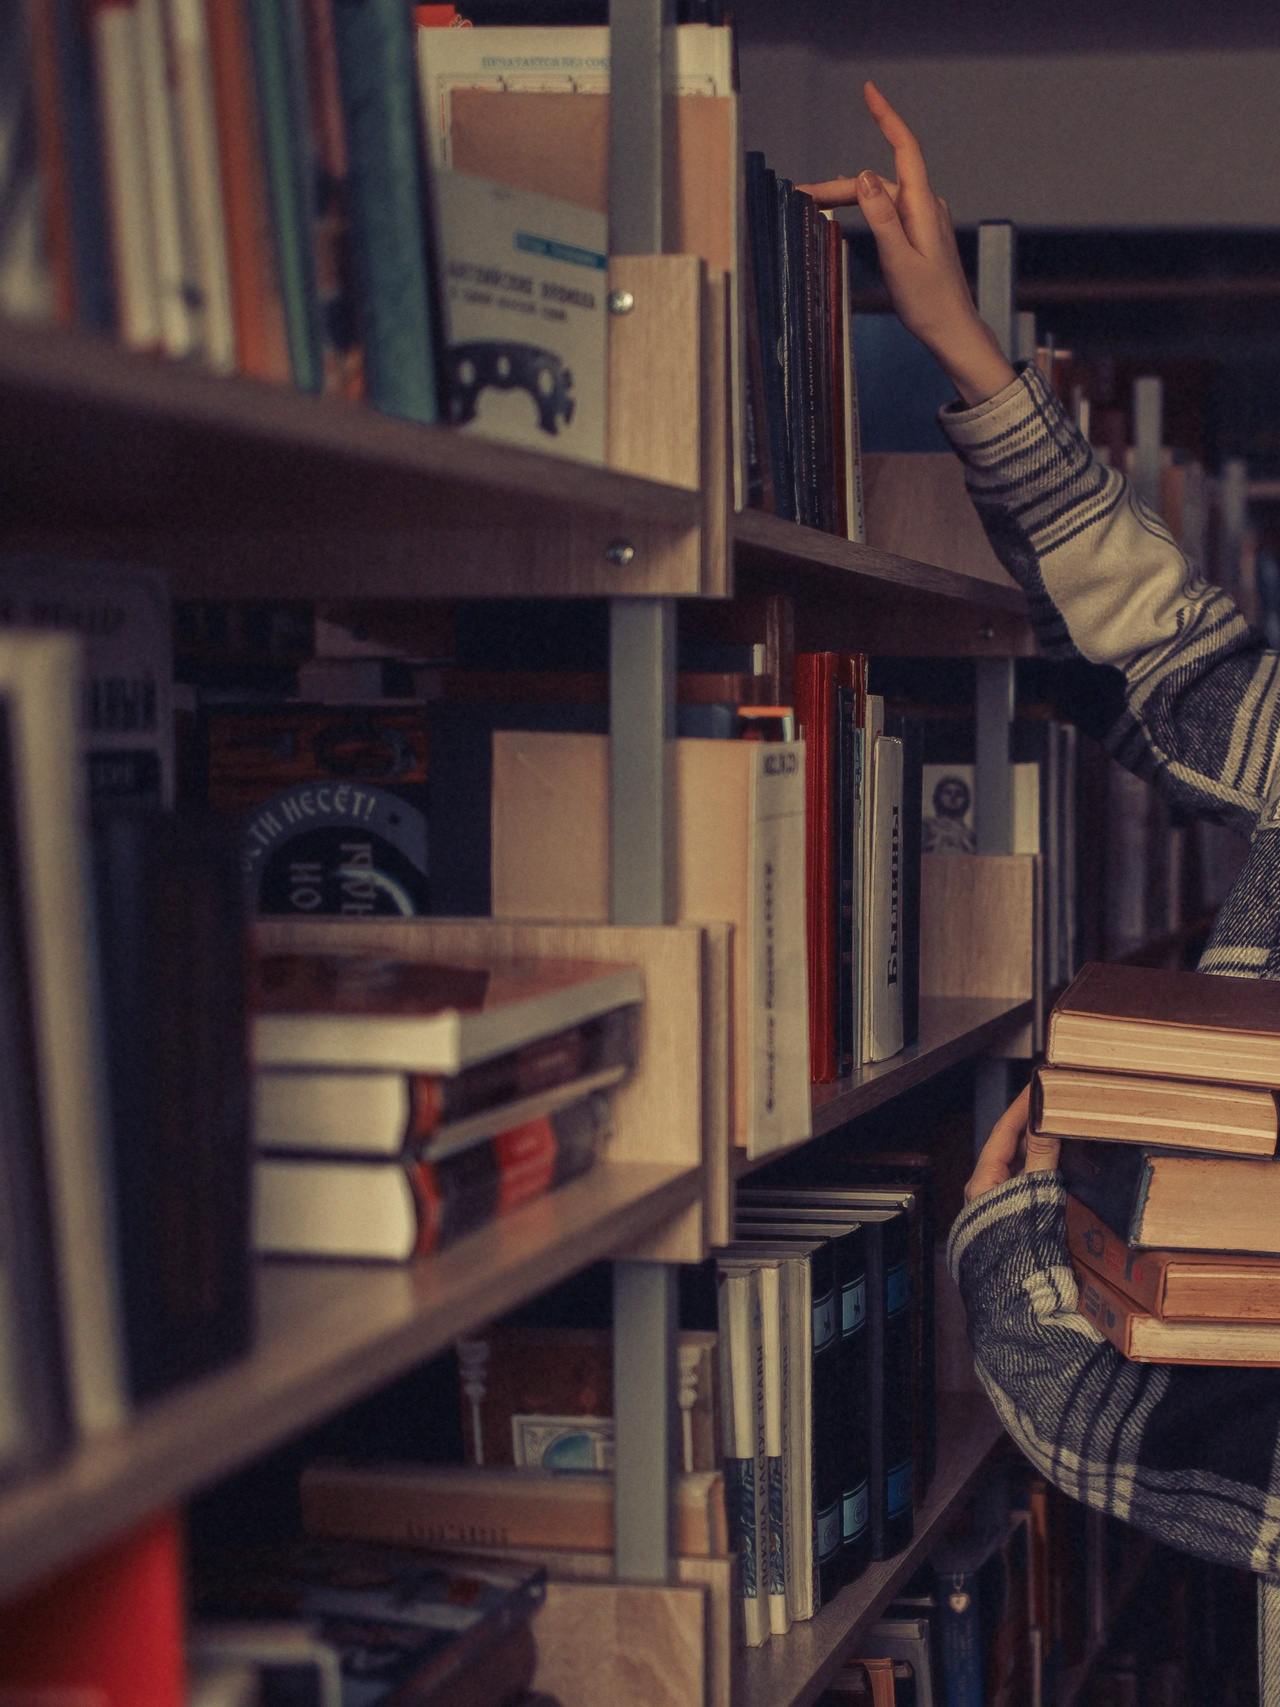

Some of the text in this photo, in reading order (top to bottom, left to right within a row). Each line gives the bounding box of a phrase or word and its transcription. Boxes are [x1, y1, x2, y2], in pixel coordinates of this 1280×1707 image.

[887, 804, 899, 989] Былины
[756, 1345, 769, 1587] ПОКУДА РАСТУТ ТРАВЫ
